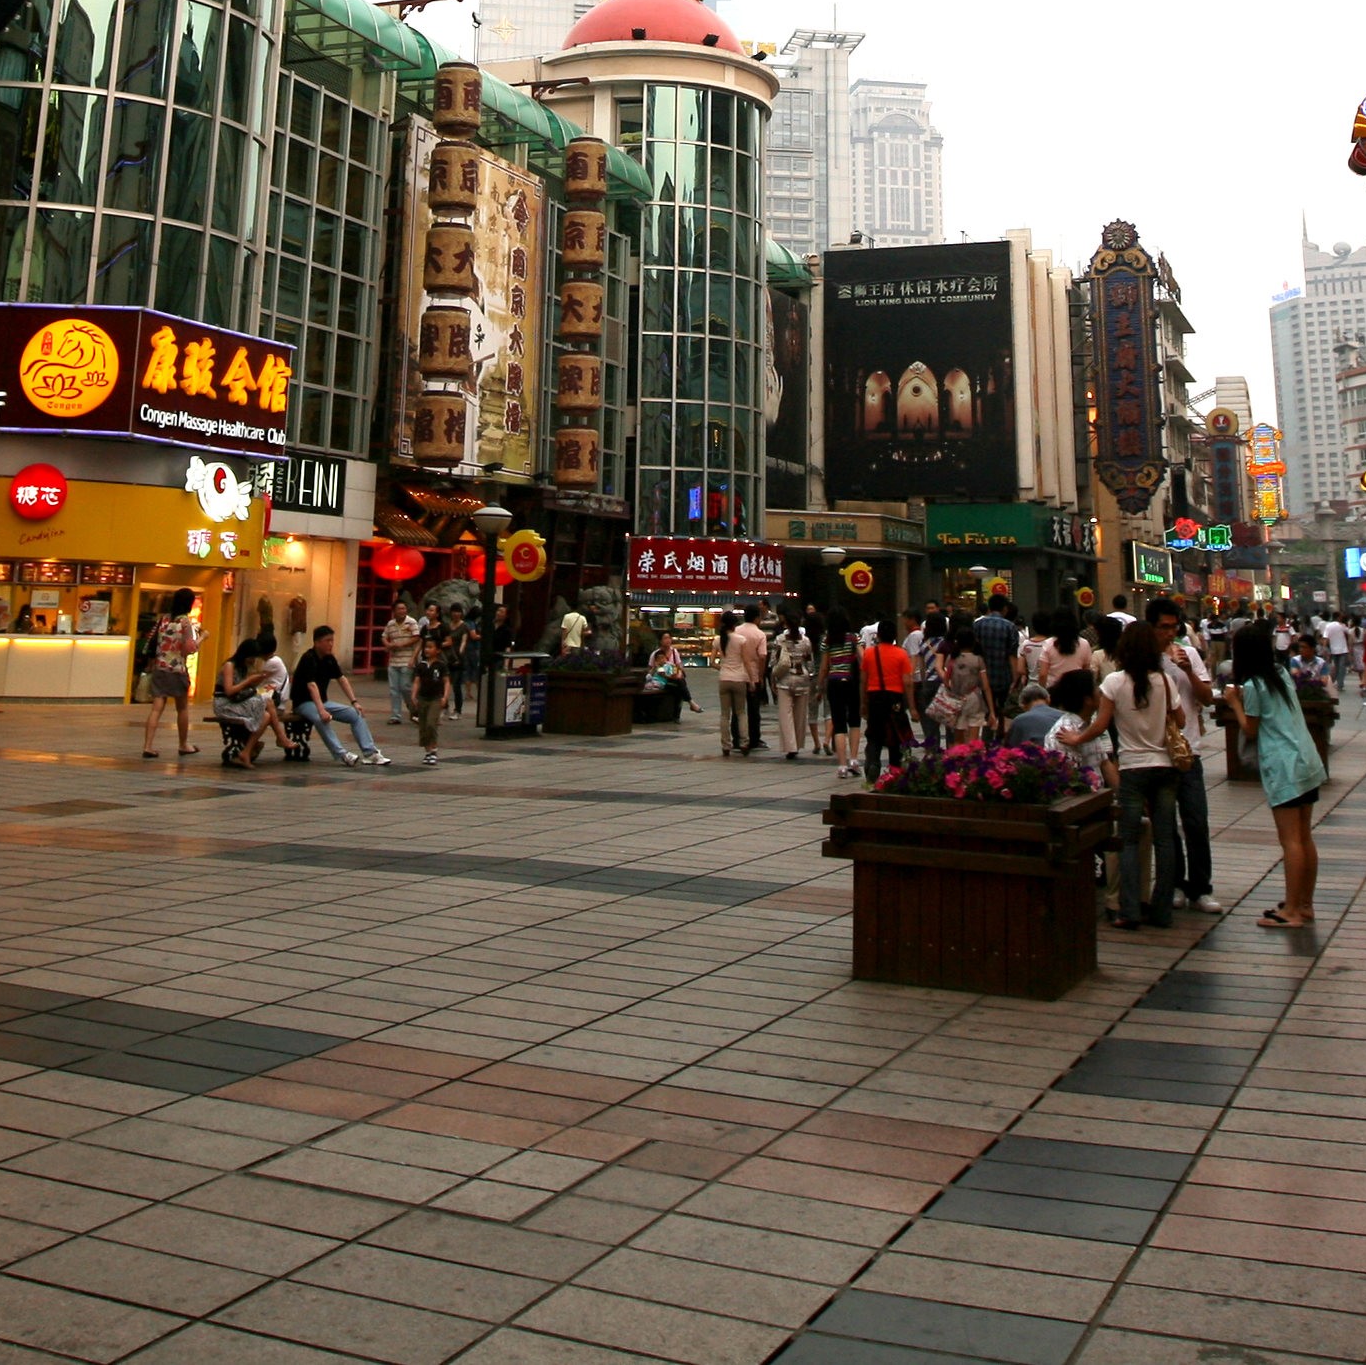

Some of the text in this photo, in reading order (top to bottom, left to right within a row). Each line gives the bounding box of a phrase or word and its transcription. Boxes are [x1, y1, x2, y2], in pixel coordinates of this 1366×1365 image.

[855, 299, 877, 307] LION
[879, 298, 902, 306] KING
[940, 293, 996, 303] COMMUNITY
[140, 403, 287, 446] Congen Massage Healthcare Club
[15, 485, 61, 506] 糖芯
[993, 536, 1017, 545] TEA
[638, 549, 729, 575] 荣氏烟酒
